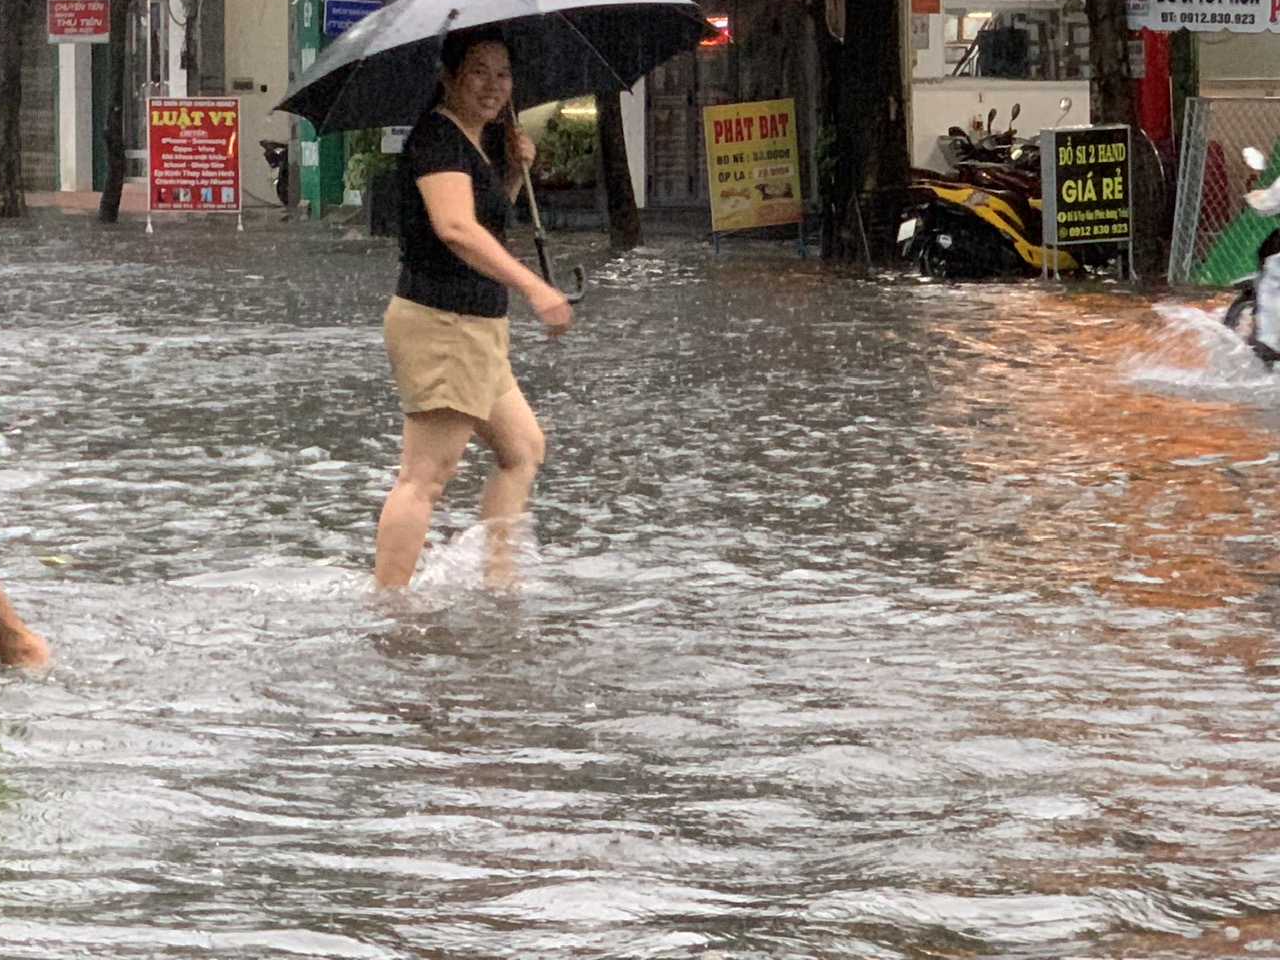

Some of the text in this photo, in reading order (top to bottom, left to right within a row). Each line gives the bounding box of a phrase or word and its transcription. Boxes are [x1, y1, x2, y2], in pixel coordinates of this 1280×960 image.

[152, 107, 236, 130] LUẬT VT
[713, 111, 754, 144] PHÁT
[1076, 145, 1086, 164] SI
[1089, 144, 1095, 163] 2
[1098, 143, 1126, 162] HAND
[1062, 168, 1123, 203] GIÁ RẺ
[1112, 223, 1128, 234] 923
